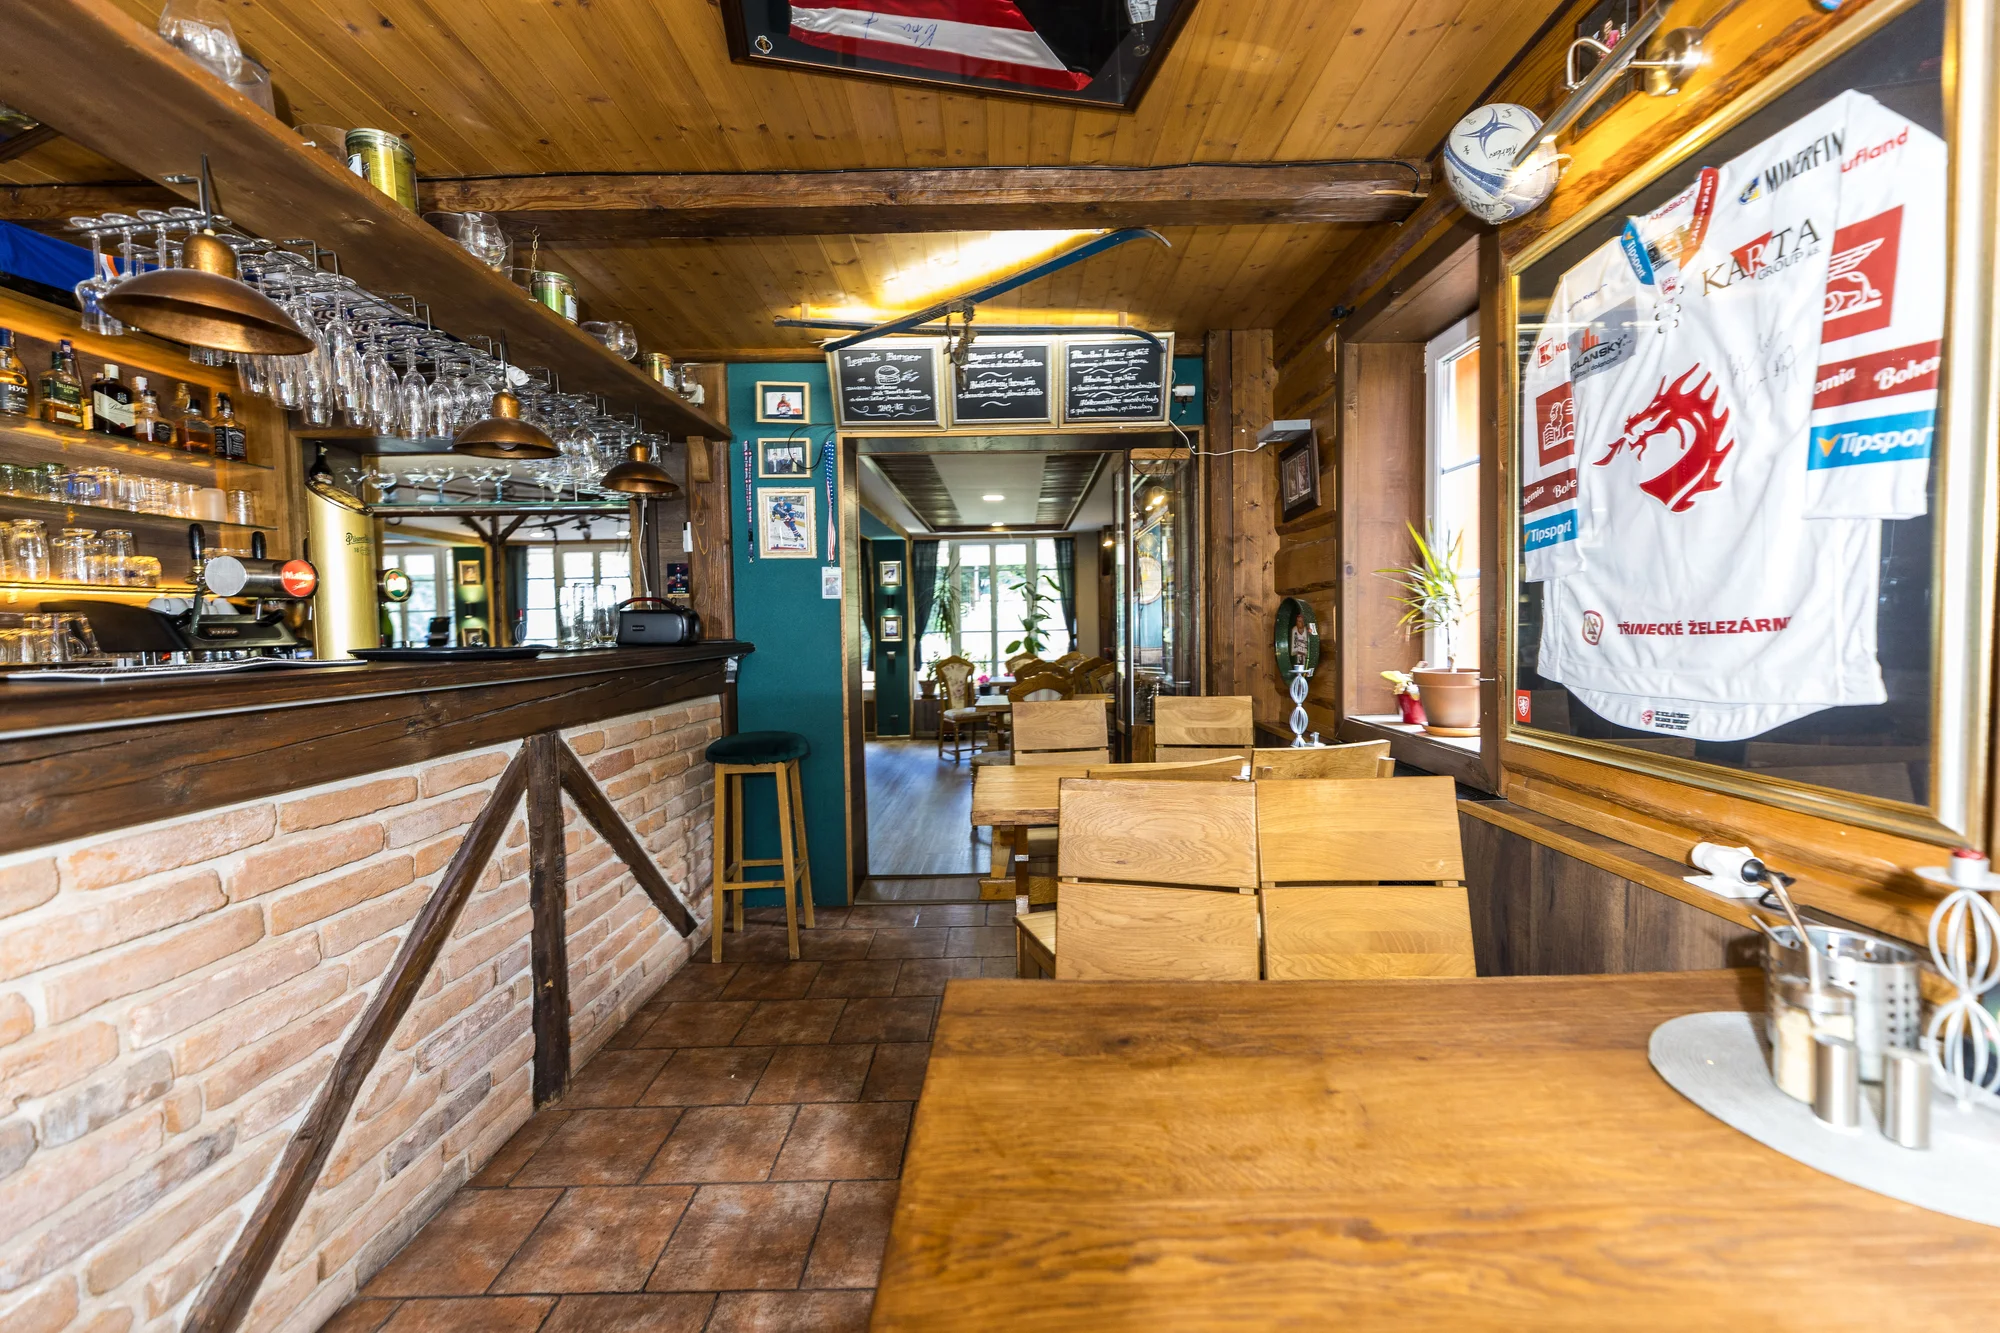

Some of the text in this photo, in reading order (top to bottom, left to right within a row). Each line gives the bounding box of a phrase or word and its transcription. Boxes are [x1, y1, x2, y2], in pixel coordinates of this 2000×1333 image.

[1625, 240, 1647, 278] Tipsport
[1702, 218, 1822, 297] KARTA
[1757, 251, 1804, 281] GROUP
[1570, 336, 1623, 373] OLANSKÝ
[1530, 519, 1572, 543] Tipsport
[1617, 616, 1794, 636] TŘINECKÉ ŽELEZÁRN
